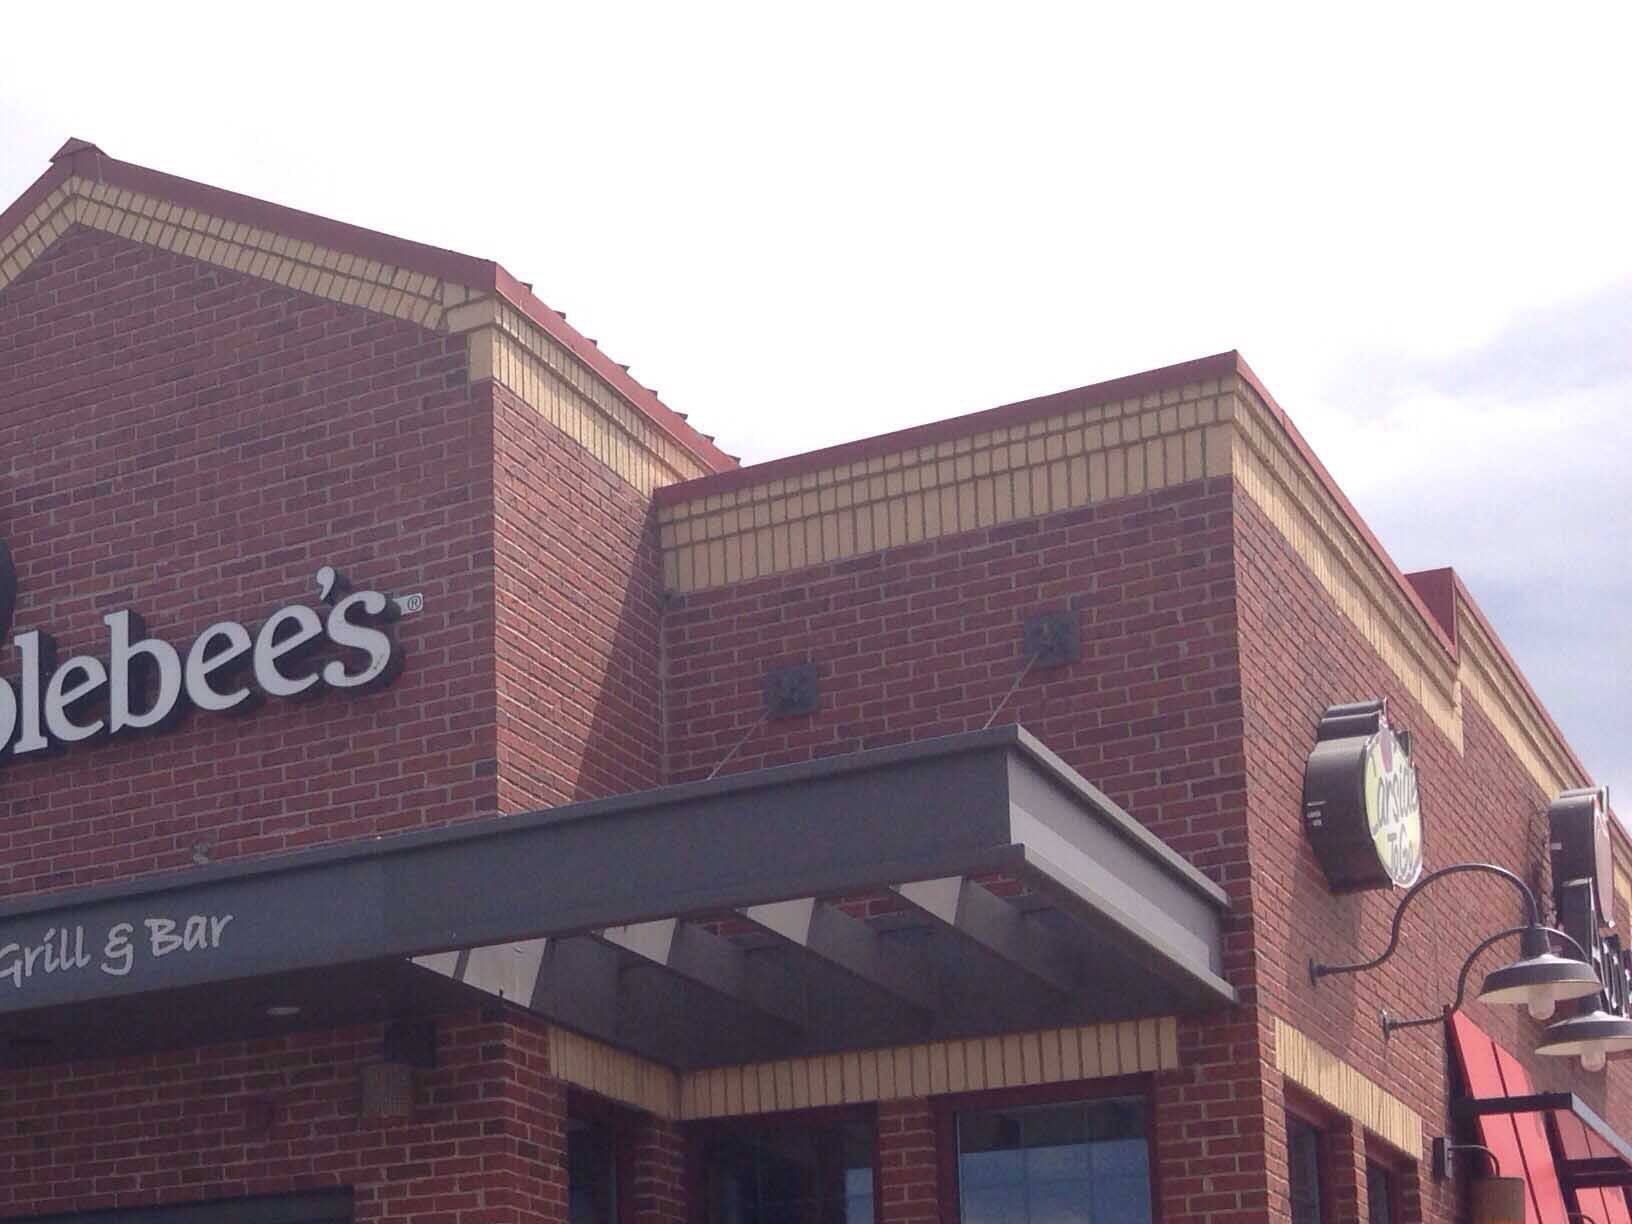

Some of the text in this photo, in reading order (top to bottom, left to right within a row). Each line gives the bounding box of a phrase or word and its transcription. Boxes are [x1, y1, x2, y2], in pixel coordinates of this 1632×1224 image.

[1365, 752, 1417, 836] Carside
[100, 922, 135, 975] &
[143, 913, 234, 959] Bar
